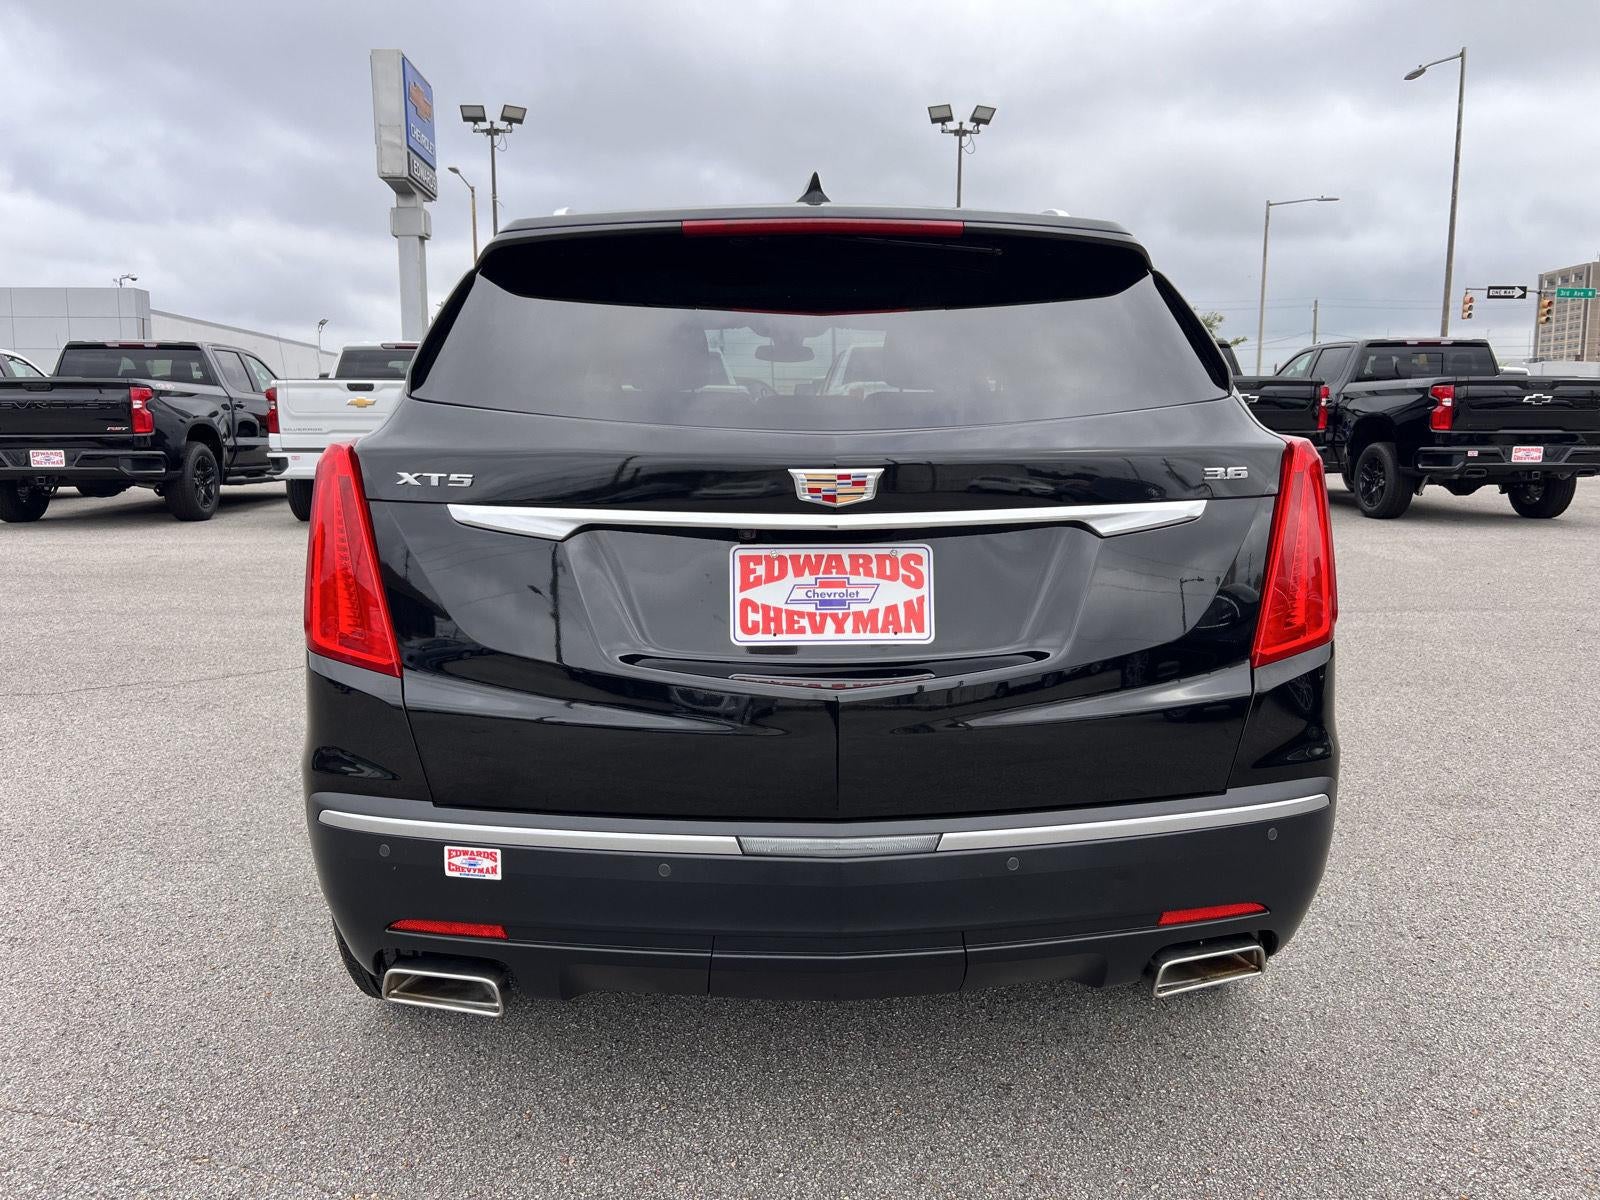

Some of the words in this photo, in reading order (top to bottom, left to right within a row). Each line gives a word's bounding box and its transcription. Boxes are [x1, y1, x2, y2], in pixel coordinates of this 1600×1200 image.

[396, 472, 474, 487] XT5
[738, 552, 926, 593] EDWARDS
[805, 588, 860, 599] Chevrolet
[738, 595, 926, 636] CHEVYMAN
[447, 848, 498, 863] EDWARDS
[447, 861, 498, 875] CHEVYMAN
